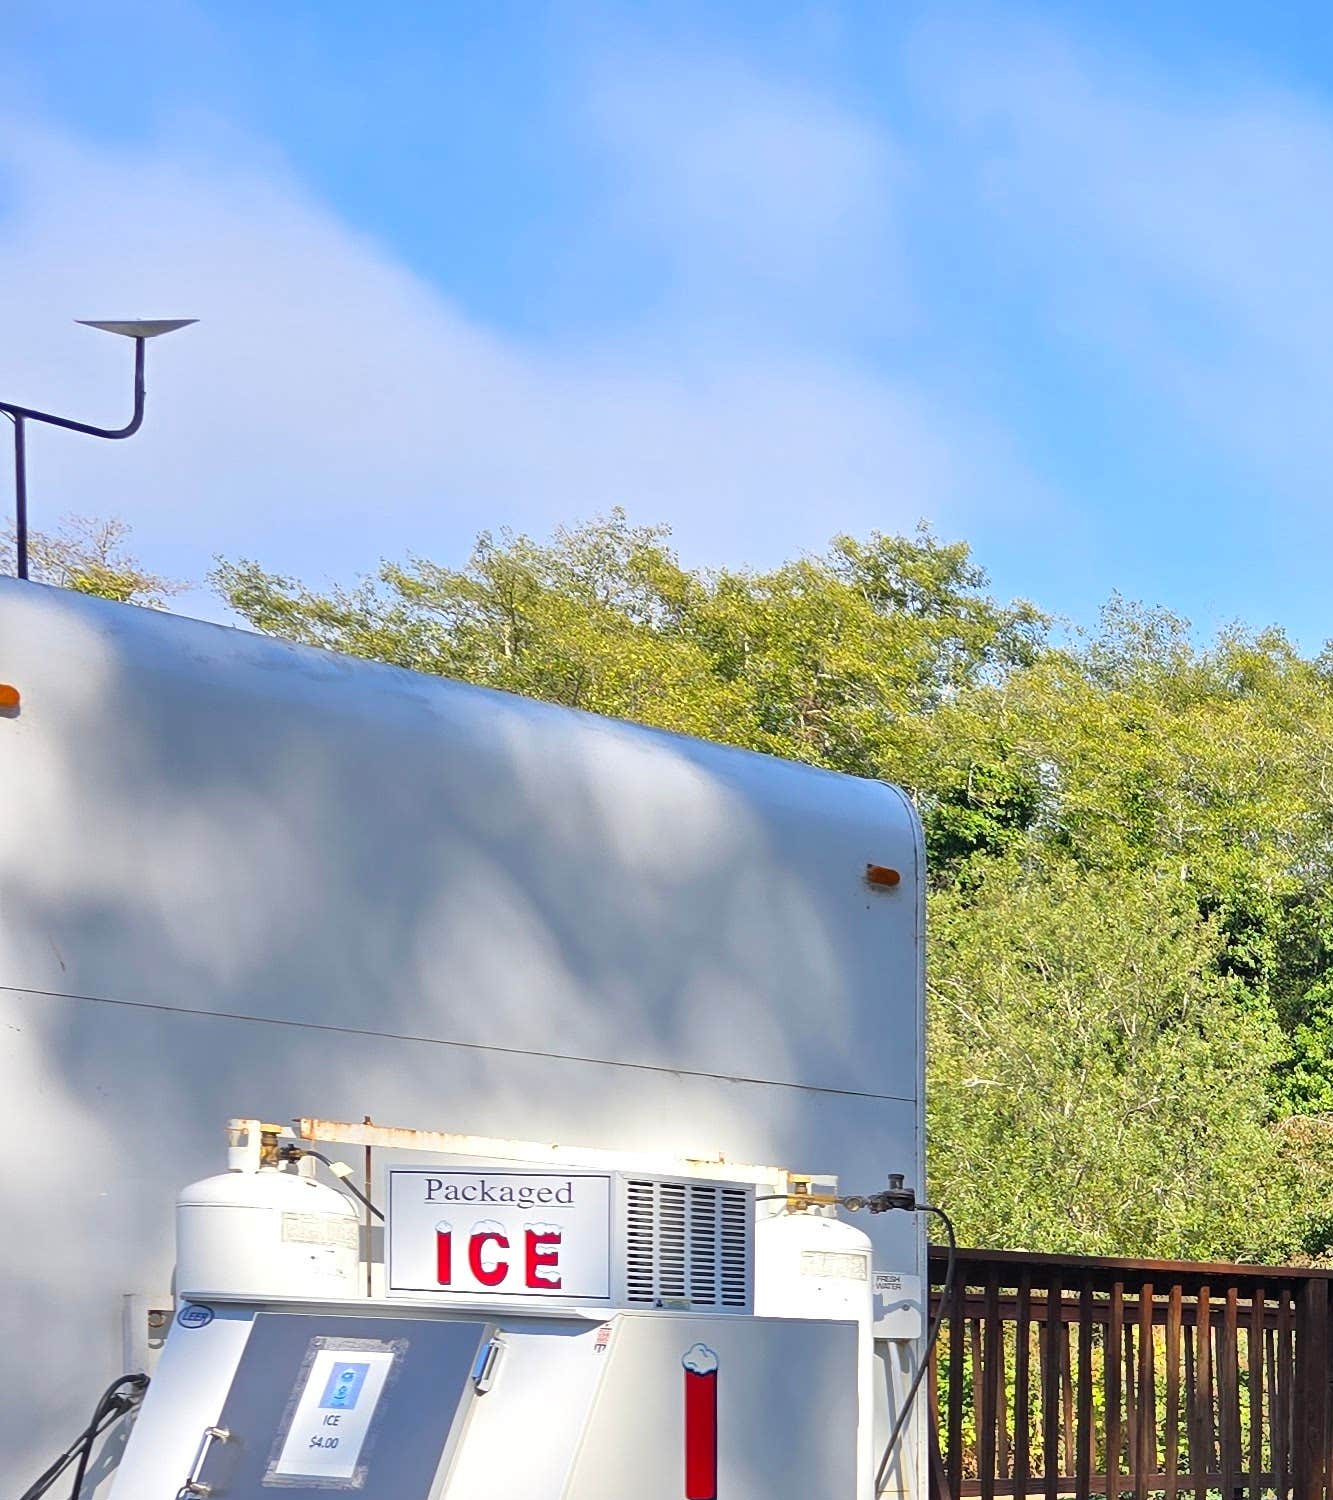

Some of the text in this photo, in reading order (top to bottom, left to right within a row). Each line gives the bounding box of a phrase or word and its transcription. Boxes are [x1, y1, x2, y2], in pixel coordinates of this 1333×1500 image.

[424, 1178, 575, 1209] Packaged
[434, 1219, 564, 1290] ICE
[323, 1414, 342, 1427] ICE
[309, 1435, 340, 1449] $4.00
